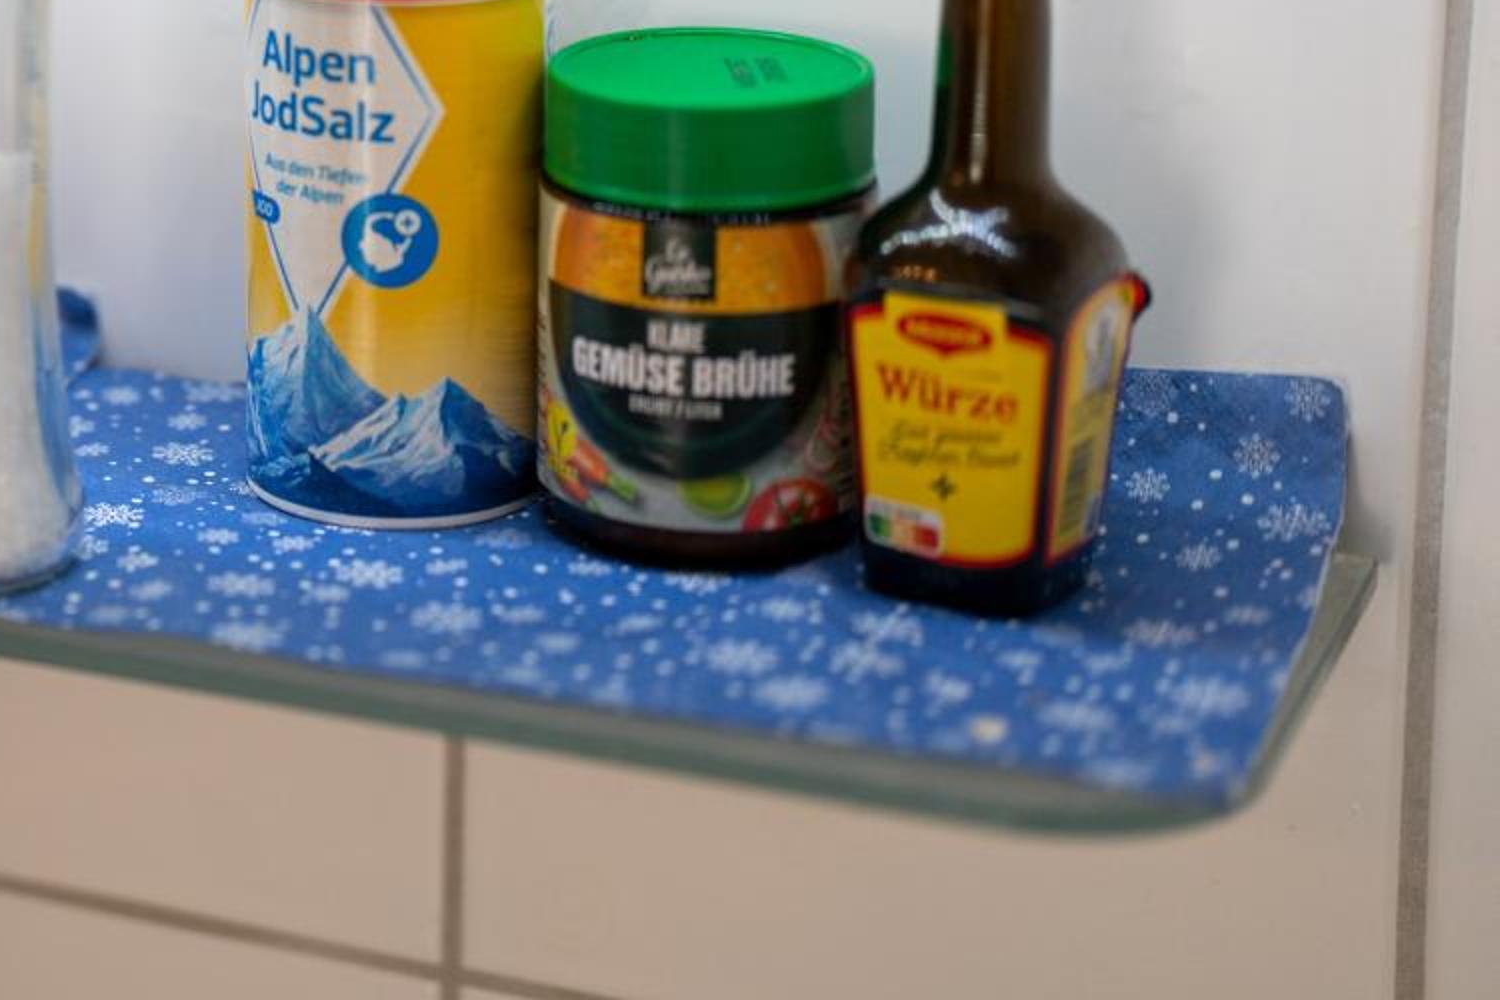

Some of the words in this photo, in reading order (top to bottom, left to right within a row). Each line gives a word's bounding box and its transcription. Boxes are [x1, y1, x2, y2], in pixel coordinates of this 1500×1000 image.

[263, 30, 377, 87] Alpen
[252, 80, 394, 144] JodSalz
[572, 334, 686, 396] GEMÜSE
[692, 350, 797, 399] BRÜHE
[877, 360, 1019, 425] Würze
